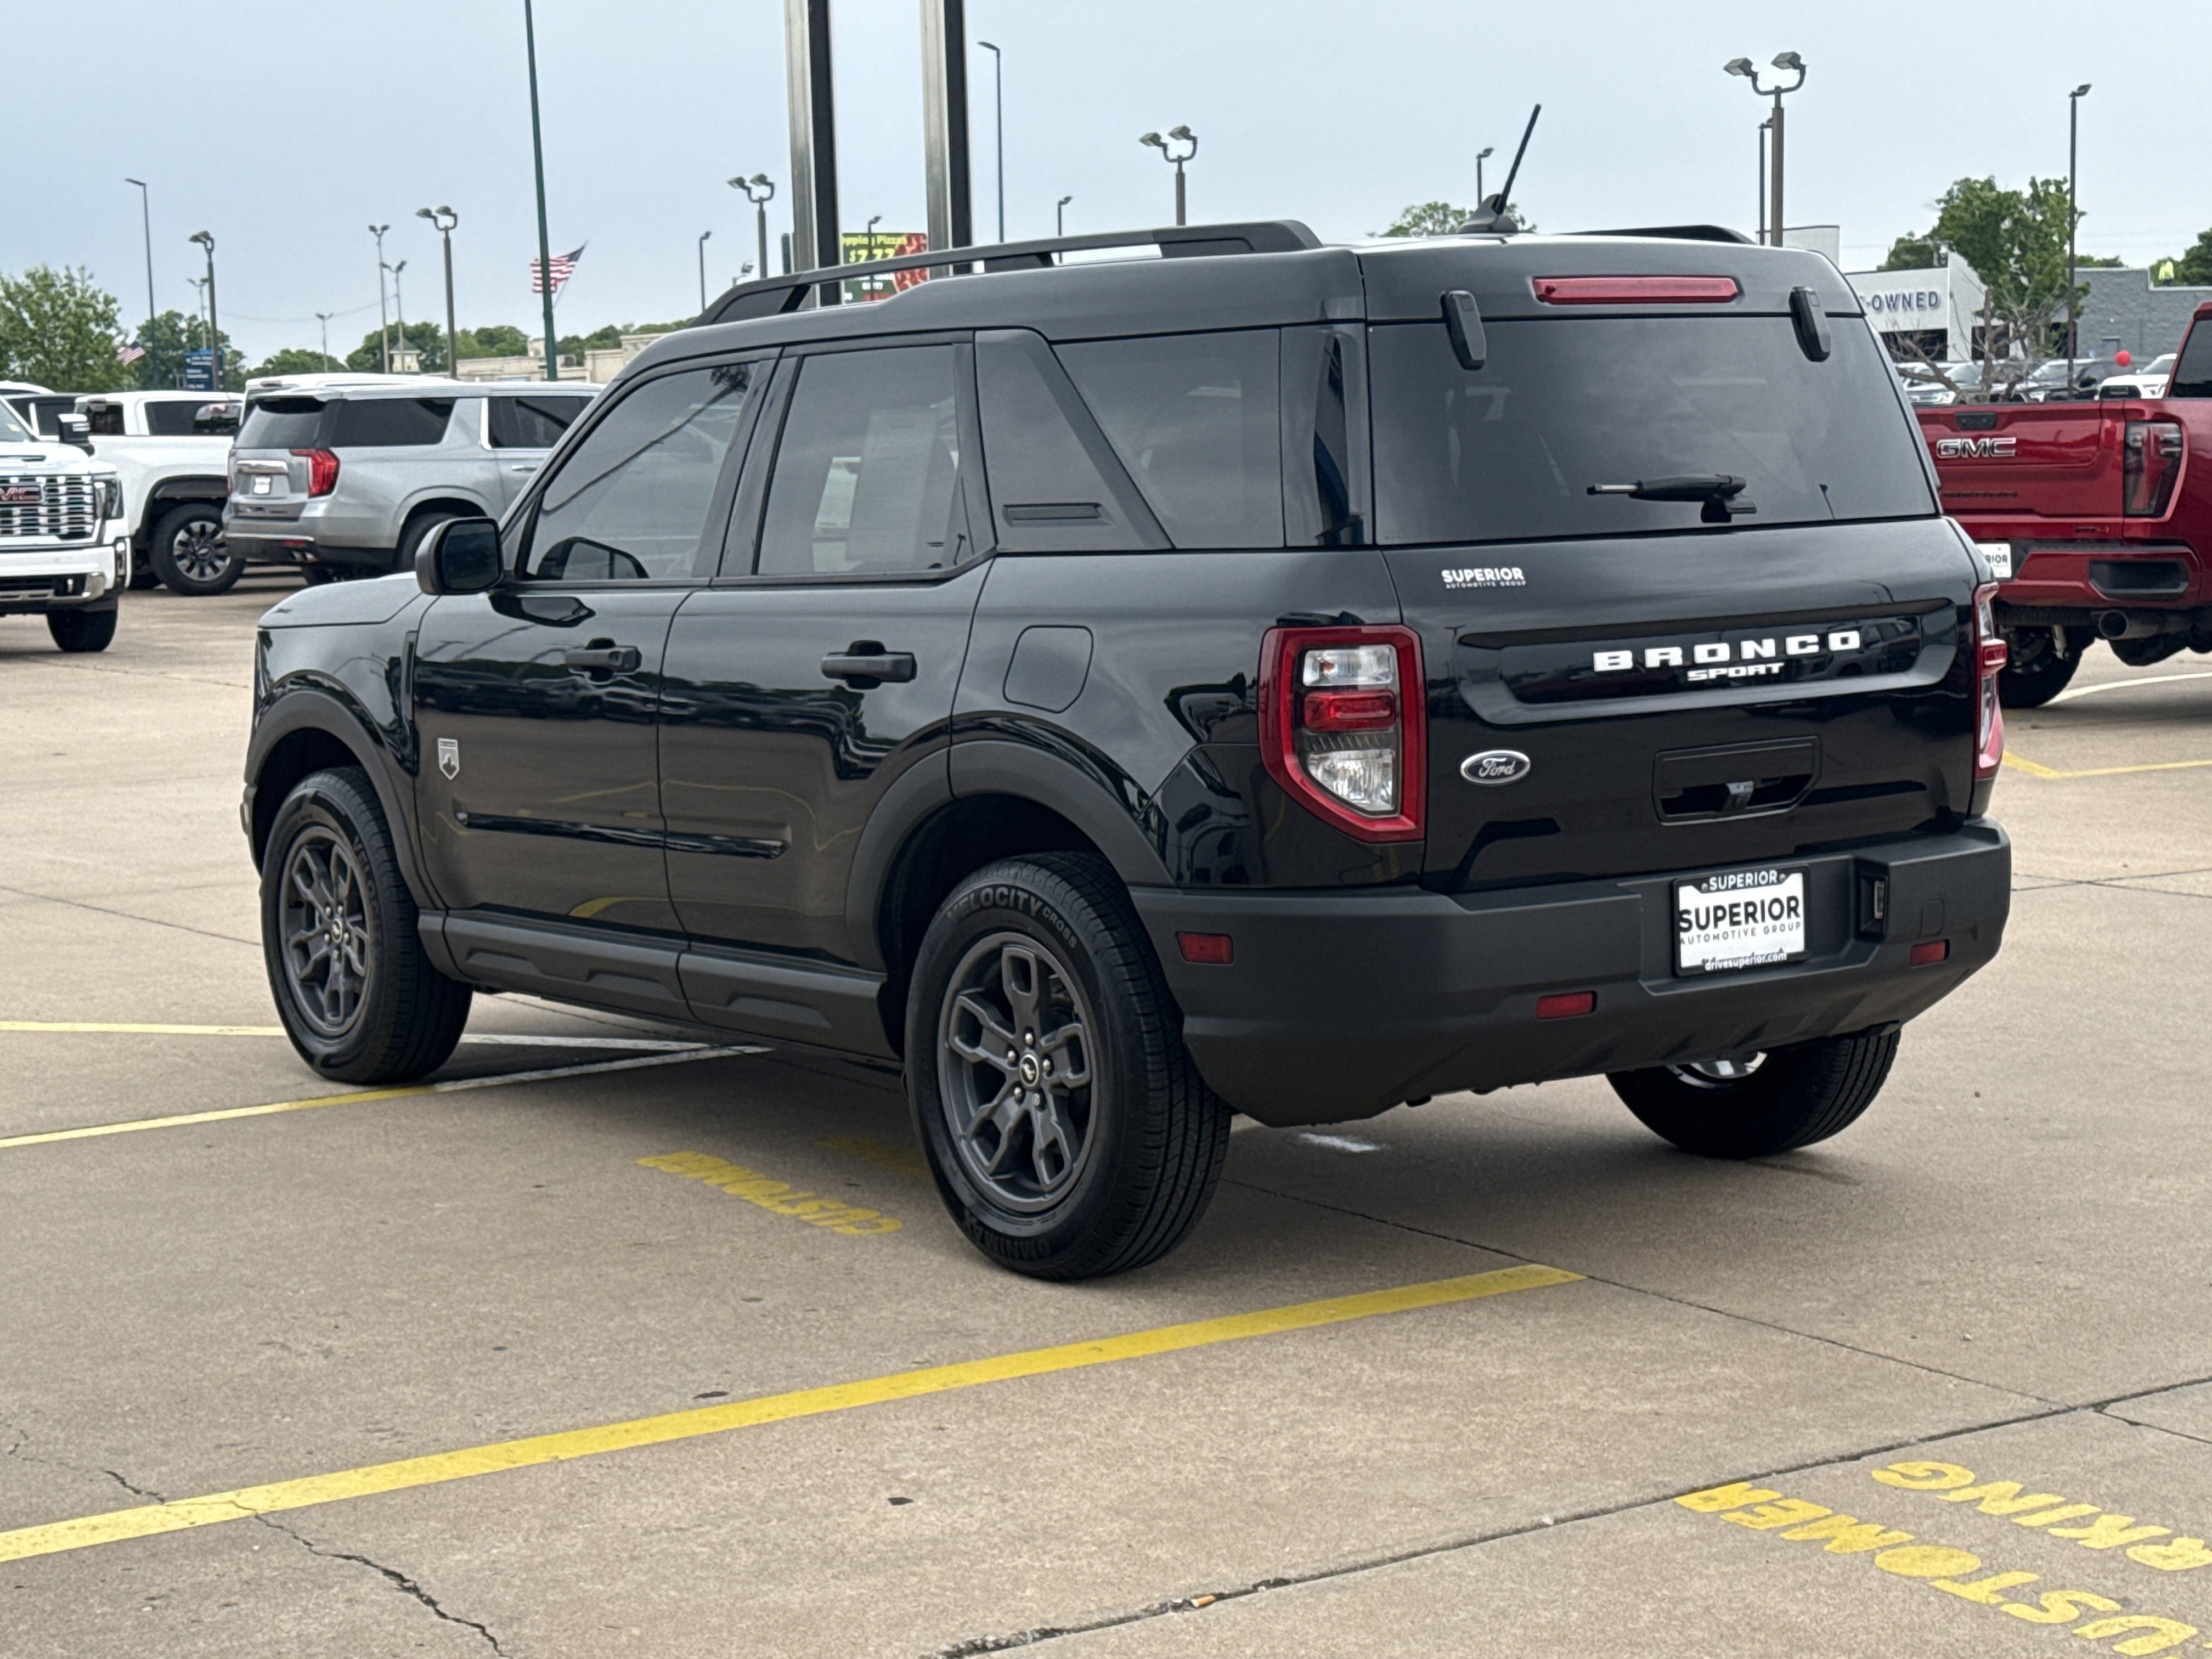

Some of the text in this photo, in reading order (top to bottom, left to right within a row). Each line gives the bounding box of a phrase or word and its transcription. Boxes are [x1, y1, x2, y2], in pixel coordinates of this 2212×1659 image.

[1859, 291, 1939, 312] -OWNED
[1936, 437, 2017, 459] GMC
[0, 486, 40, 501] MC
[1985, 554, 2008, 564] RIOR
[1441, 567, 1525, 583] SUPERIOR
[1593, 631, 1860, 672] BRONCO
[1687, 663, 1785, 681] SPORT
[1479, 757, 1516, 777] Ford
[1708, 870, 1778, 891] SUPERIOR
[946, 886, 1078, 949] VELOCITY CROSS
[1679, 895, 1801, 933] SUPERIOR
[1680, 921, 1801, 946] AUTOMOTIVE GROUP
[1705, 952, 1787, 971] drivesuperior.com
[1871, 1461, 2212, 1571] RKING
[1674, 1482, 2212, 1659] USTOMER
